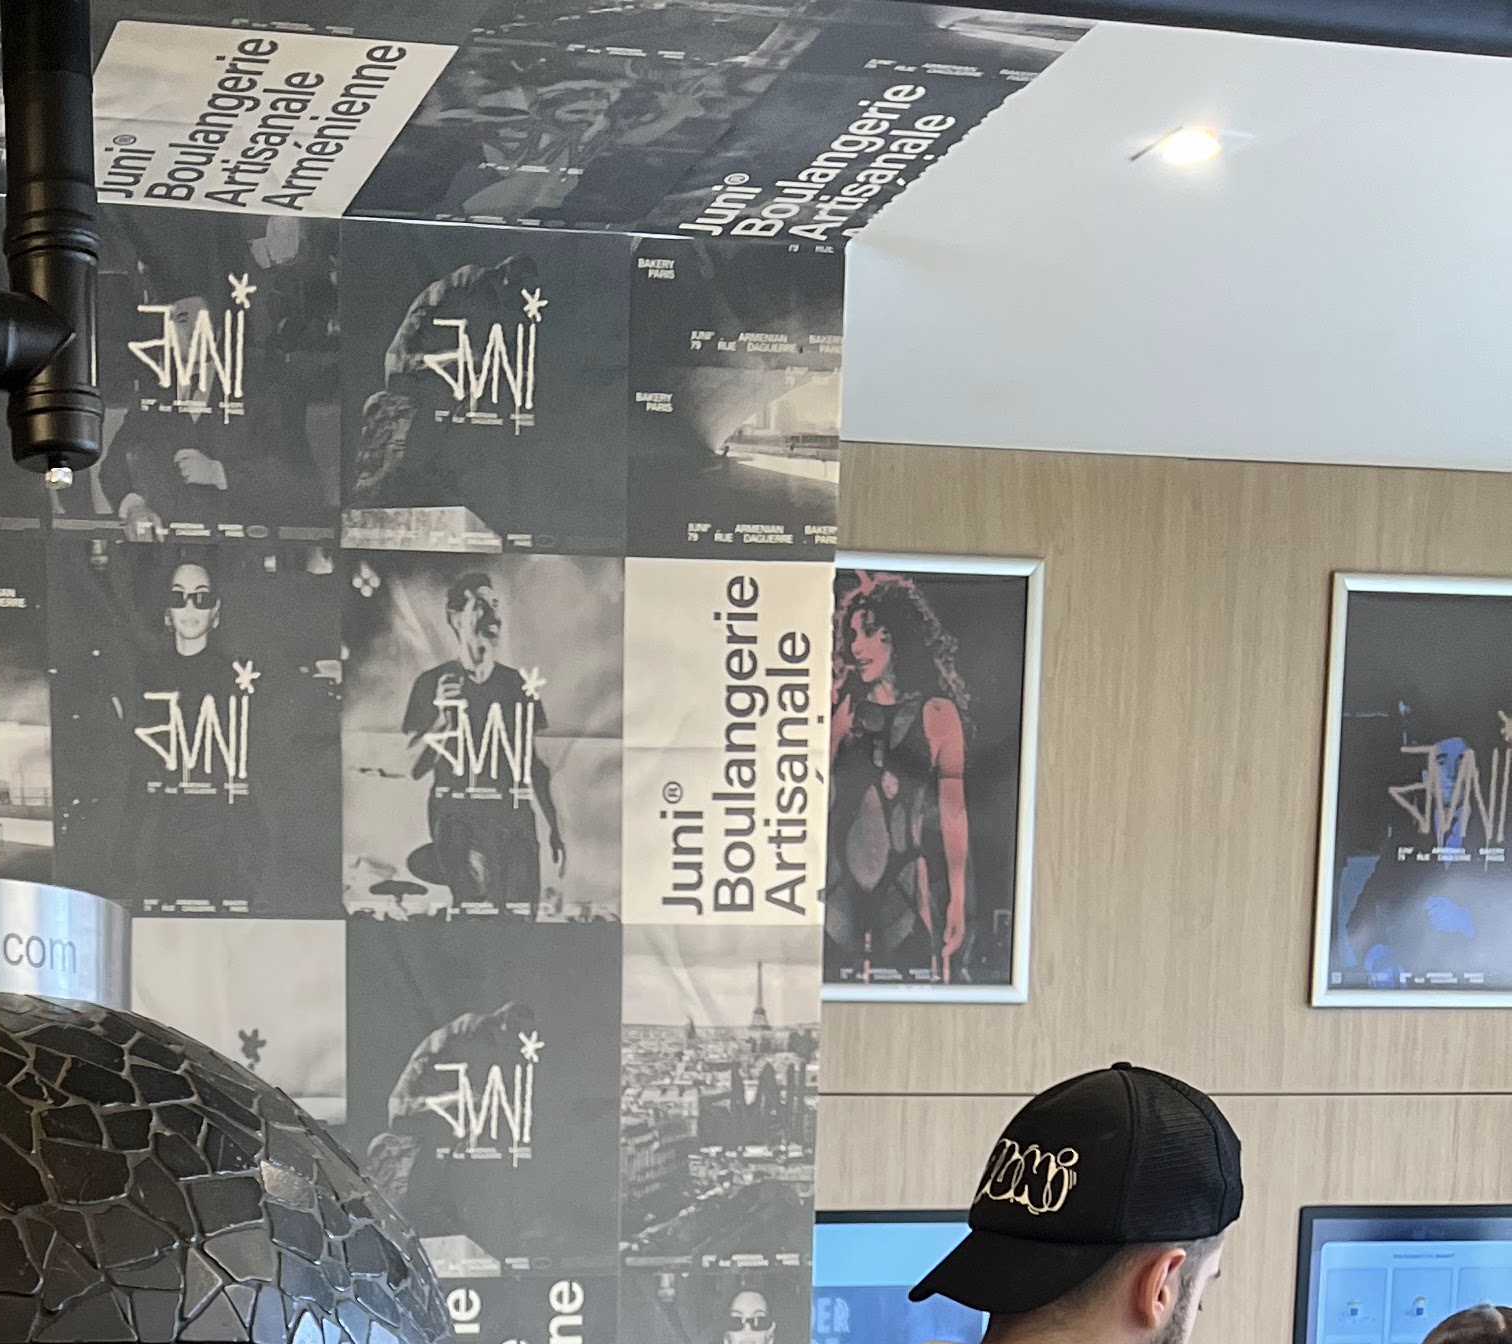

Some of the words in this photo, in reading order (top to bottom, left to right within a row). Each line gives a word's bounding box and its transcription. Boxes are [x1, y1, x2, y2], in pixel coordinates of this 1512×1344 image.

[144, 36, 279, 202] Boulangerie
[204, 69, 325, 209] Artisanale
[262, 43, 407, 212] Arménienne
[730, 83, 926, 239] Boulangerie
[787, 114, 956, 242] Artisanale
[638, 258, 676, 269] BAKERY
[648, 269, 676, 280] PARIS
[635, 392, 674, 403] BAKERY
[646, 402, 674, 413] PARIS
[712, 574, 769, 914] Boulangerie
[765, 630, 812, 917] Artisanale
